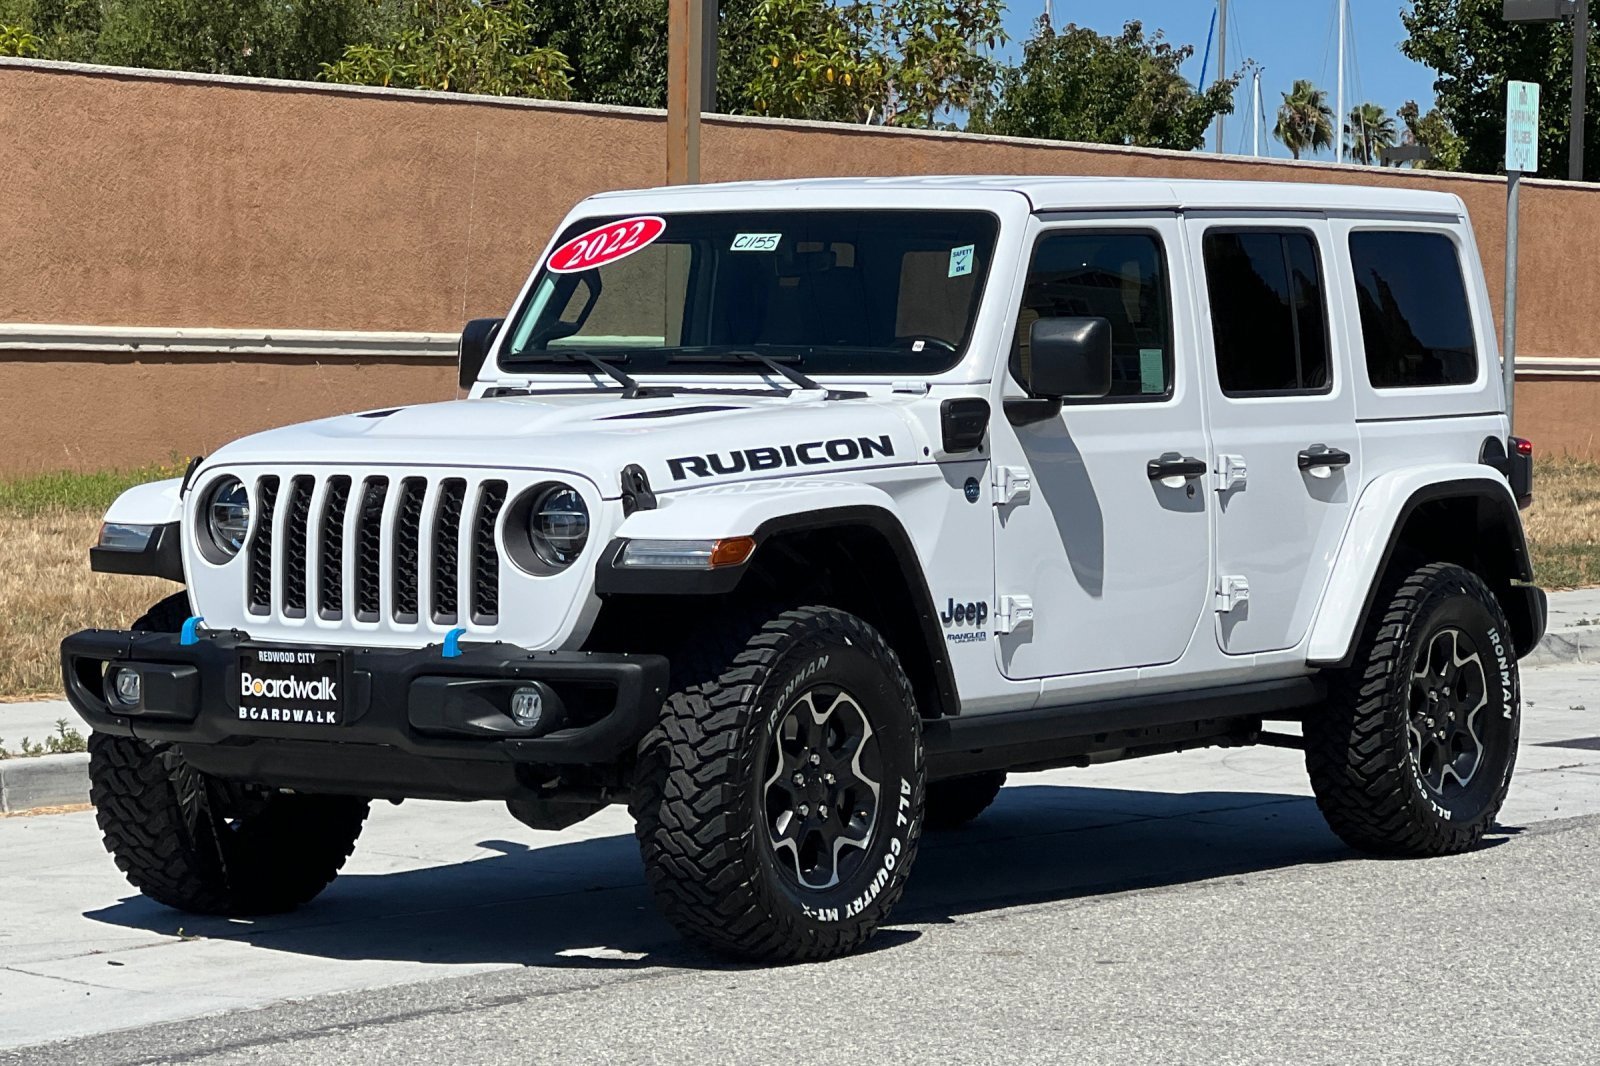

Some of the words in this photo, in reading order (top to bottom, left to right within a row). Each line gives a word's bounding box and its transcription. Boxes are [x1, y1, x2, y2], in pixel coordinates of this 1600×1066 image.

[563, 221, 645, 268] 2022
[734, 235, 777, 249] C1155
[953, 248, 972, 257] SAFETY
[666, 435, 895, 481] RUBICON
[941, 598, 988, 626] Jeep
[947, 632, 986, 640] WRANGLER
[258, 651, 295, 663] REDWOOD
[297, 653, 316, 664] CITY
[241, 672, 337, 700] Boardwalk
[1488, 627, 1512, 719] IRONMAN
[767, 655, 829, 735] IRONMAN
[239, 707, 336, 723] BOARDWALK
[896, 776, 911, 827] ALL
[1431, 800, 1452, 820] ALL
[845, 837, 901, 920] COUNTRY
[801, 903, 838, 921] MT-X
